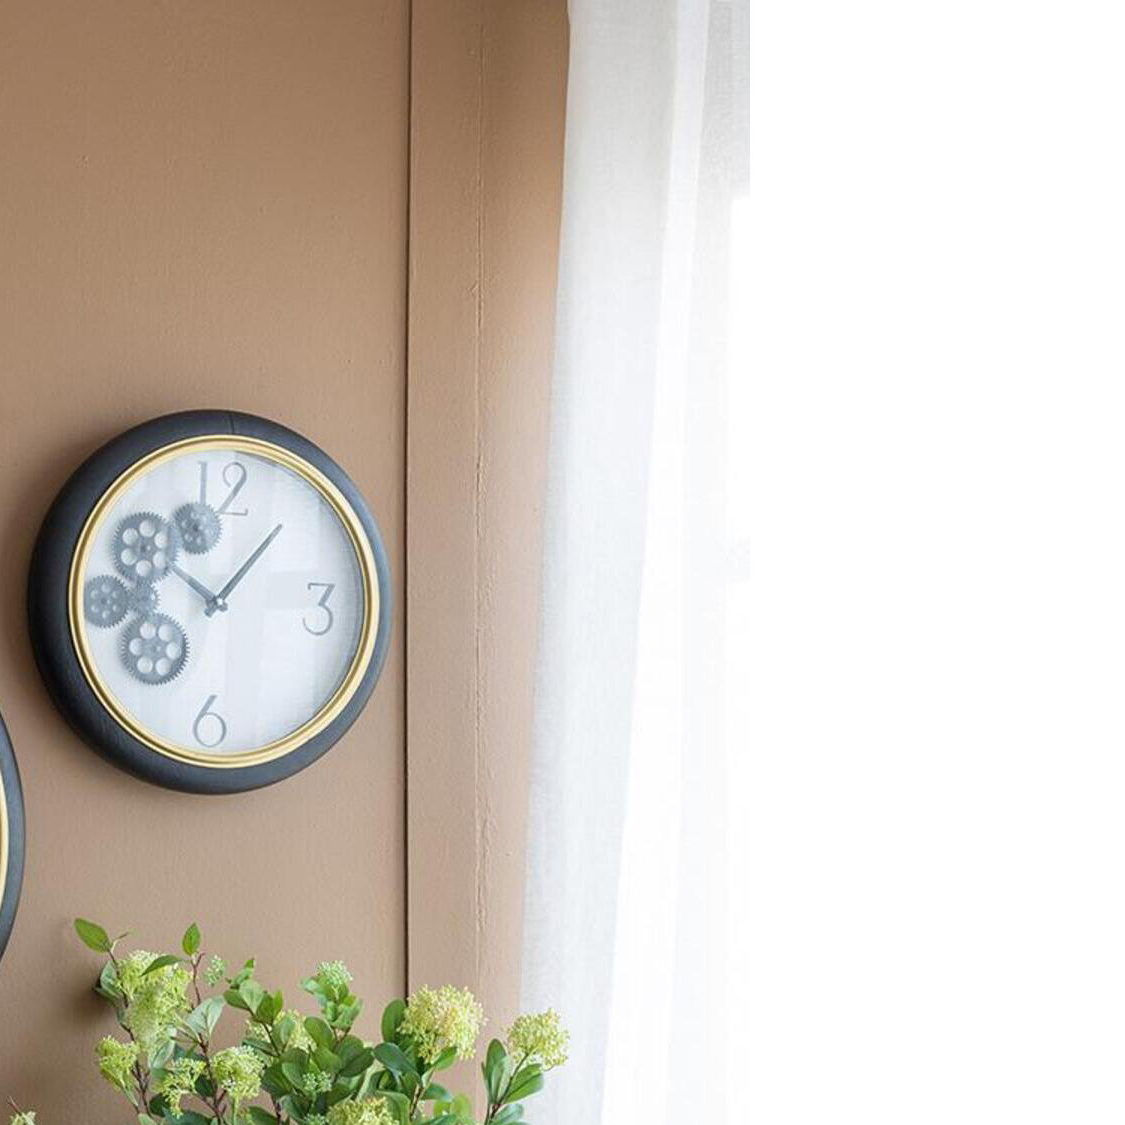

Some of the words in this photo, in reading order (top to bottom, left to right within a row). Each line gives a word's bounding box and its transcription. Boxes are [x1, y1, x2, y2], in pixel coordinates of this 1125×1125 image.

[197, 462, 249, 516] 12
[302, 582, 336, 636] 3
[193, 694, 227, 748] 6
